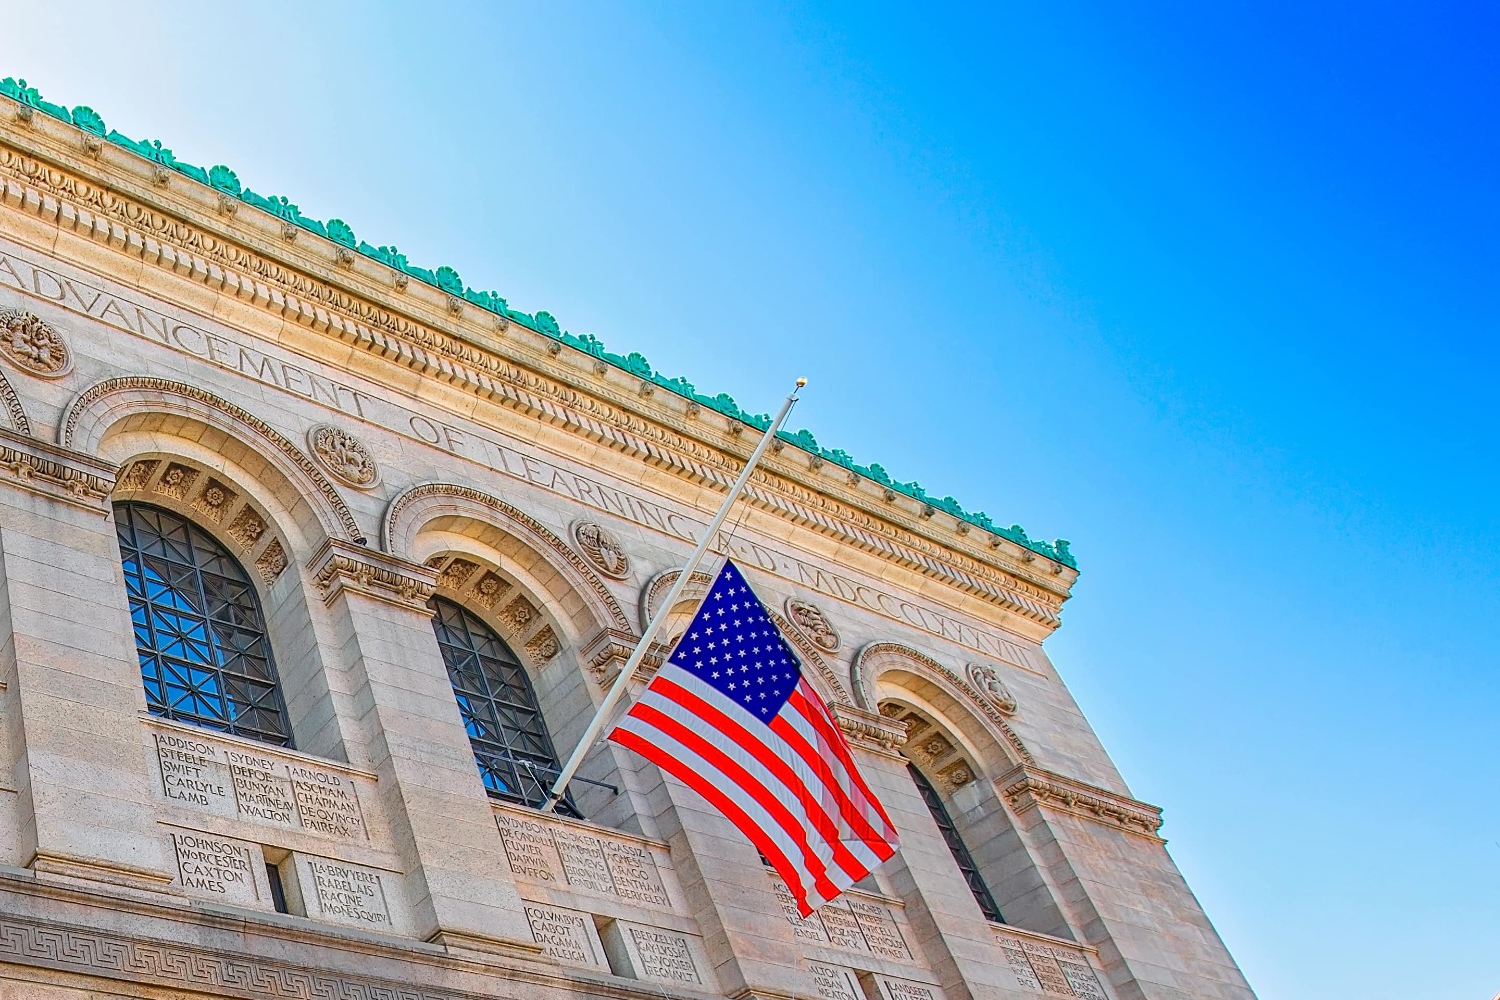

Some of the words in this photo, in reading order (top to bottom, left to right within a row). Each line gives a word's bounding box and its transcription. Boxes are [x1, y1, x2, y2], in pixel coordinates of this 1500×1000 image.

[409, 416, 465, 452] OF
[497, 447, 696, 542] LEARNING
[159, 734, 215, 756] ADDISON
[160, 747, 207, 768] STEELE
[231, 752, 275, 770] SYDNEY
[163, 760, 201, 778] SWIFT
[233, 764, 272, 782] DEFOE
[292, 767, 340, 786] ARNOLD
[165, 775, 225, 796] CARLYLE
[236, 778, 286, 798] BUNYAN
[295, 780, 348, 800] ASCHAM
[168, 788, 209, 806] LAMB
[238, 791, 294, 811] MARTINEAV
[297, 792, 356, 812] CHAPMAN
[240, 804, 291, 824] WALTON
[303, 818, 351, 836] FAIRFAX
[177, 834, 242, 857] JOHNSON
[505, 840, 543, 856] CUVIER
[603, 841, 646, 858] AGASSIZ
[179, 848, 248, 871] WORCESTER
[509, 852, 549, 868] DARWIN
[182, 862, 244, 884] CAXTON
[513, 864, 556, 882] BVFFON
[611, 865, 649, 880] ARAGO
[185, 877, 225, 894] AMES
[317, 876, 374, 897] RABELAIS
[615, 876, 664, 894] BENTHAM
[320, 889, 363, 906] RACINE
[619, 888, 666, 905] BERKELEY
[850, 901, 884, 915] WAGNER
[527, 907, 582, 928] COLVMBVS
[532, 919, 571, 937] CABOT
[827, 925, 862, 940] MOZART
[860, 923, 895, 937] PVRCELL
[832, 936, 861, 949] GLVCK
[814, 977, 844, 990] AUBAN
